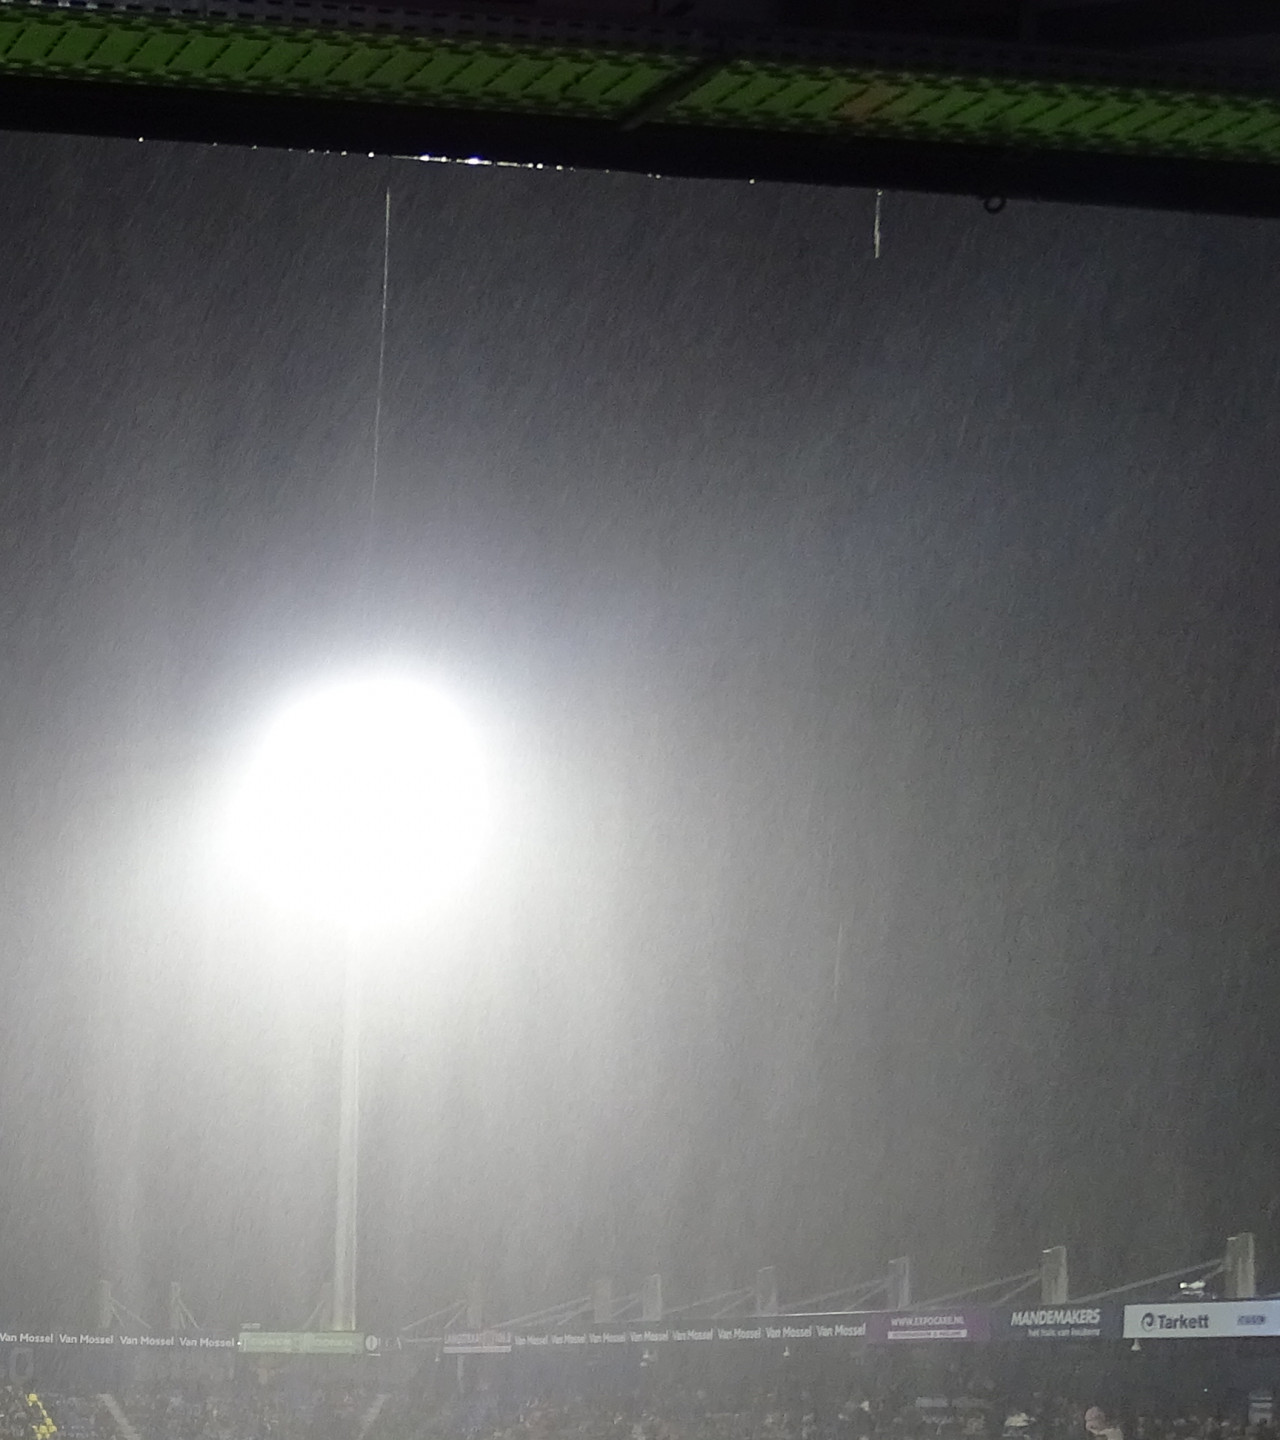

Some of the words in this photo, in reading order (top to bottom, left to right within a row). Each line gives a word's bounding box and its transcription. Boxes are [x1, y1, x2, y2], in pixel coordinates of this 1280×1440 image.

[1011, 1308, 1100, 1326] MANDEMAKERS
[1157, 1314, 1209, 1329] Tarkett
[765, 1327, 780, 1338] Van
[782, 1326, 811, 1338] Mossel
[816, 1325, 833, 1336] Van
[835, 1323, 866, 1336] Mossel
[0, 1333, 17, 1342] Van
[20, 1333, 53, 1343] Mossel
[59, 1334, 77, 1344] Van
[80, 1334, 113, 1344] Mossel
[120, 1335, 138, 1345] Van
[140, 1336, 174, 1346] Mossel
[180, 1337, 197, 1347] Van
[200, 1337, 235, 1347] Mossel
